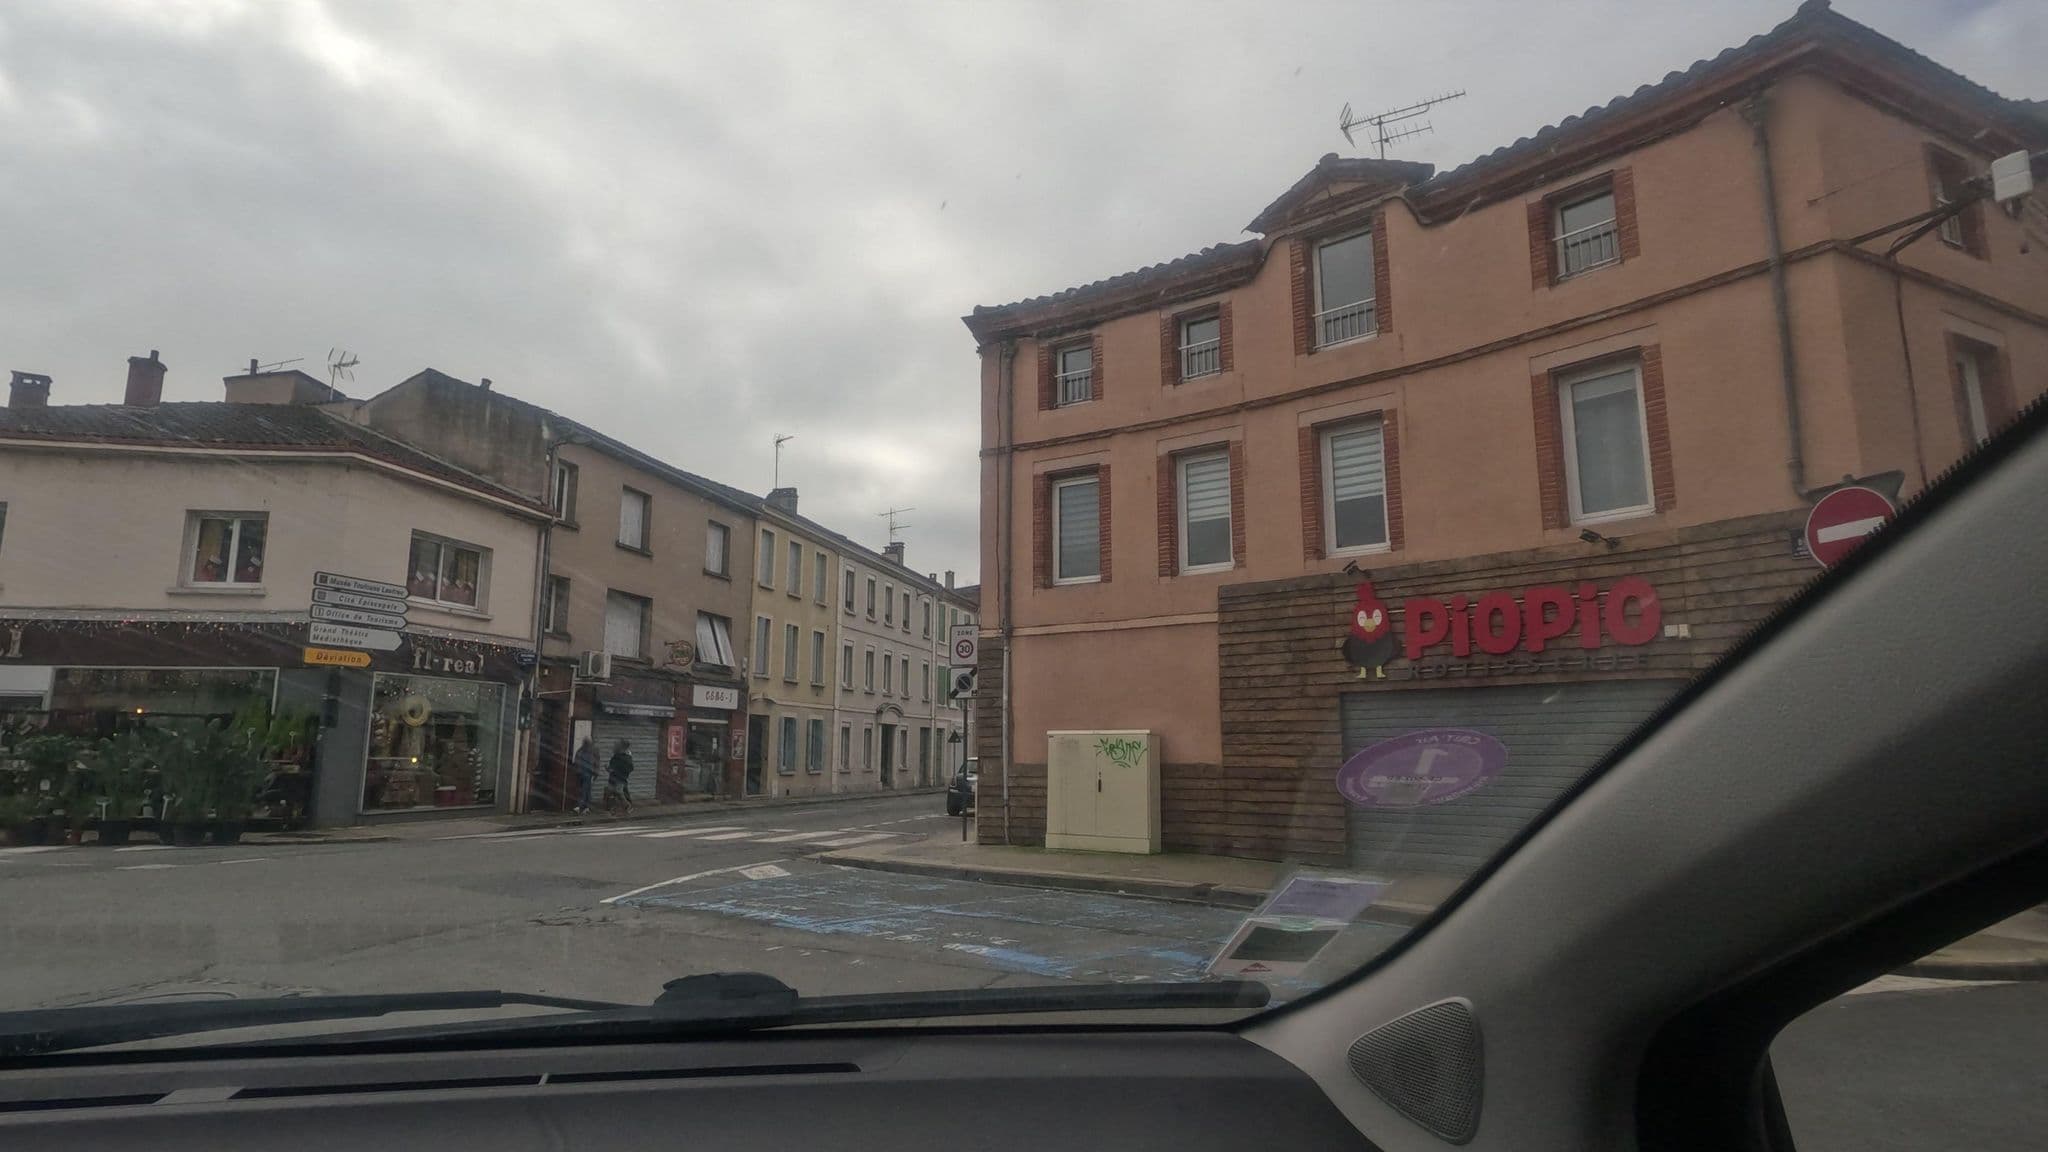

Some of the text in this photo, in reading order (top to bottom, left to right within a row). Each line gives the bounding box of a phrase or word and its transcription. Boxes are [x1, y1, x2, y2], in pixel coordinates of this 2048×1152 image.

[354, 582, 380, 592] Toulouse
[326, 610, 350, 619] Office
[366, 615, 399, 626] Tourisme
[313, 625, 337, 634] Grand
[959, 644, 971, 653] 30
